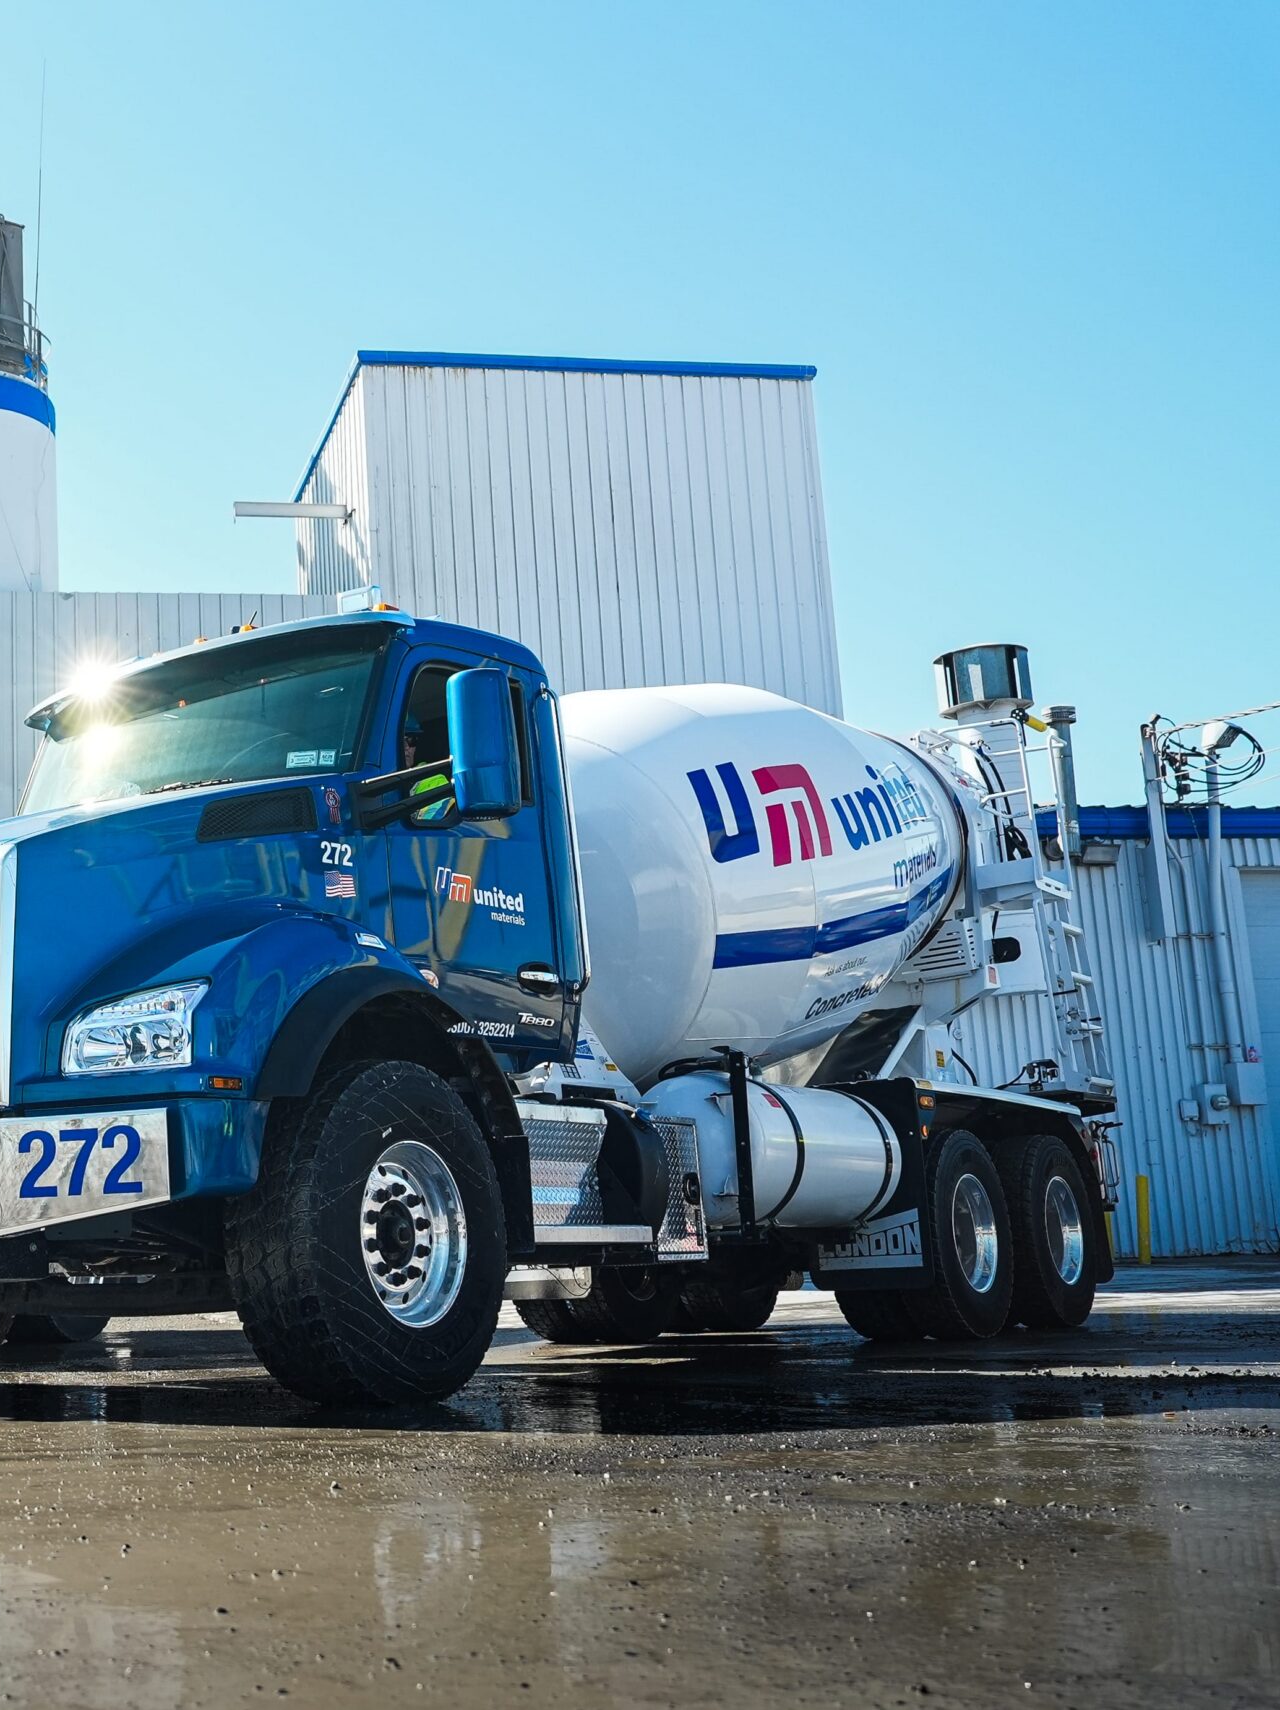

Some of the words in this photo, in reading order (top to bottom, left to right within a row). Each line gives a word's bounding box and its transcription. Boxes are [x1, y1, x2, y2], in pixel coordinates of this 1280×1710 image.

[831, 761, 927, 851] united
[320, 841, 353, 867] 272
[893, 838, 937, 889] materials
[473, 886, 525, 913] united
[491, 911, 526, 926] materials
[477, 1021, 516, 1038] 3252214
[518, 1012, 555, 1027] T880
[18, 1125, 143, 1198] 272
